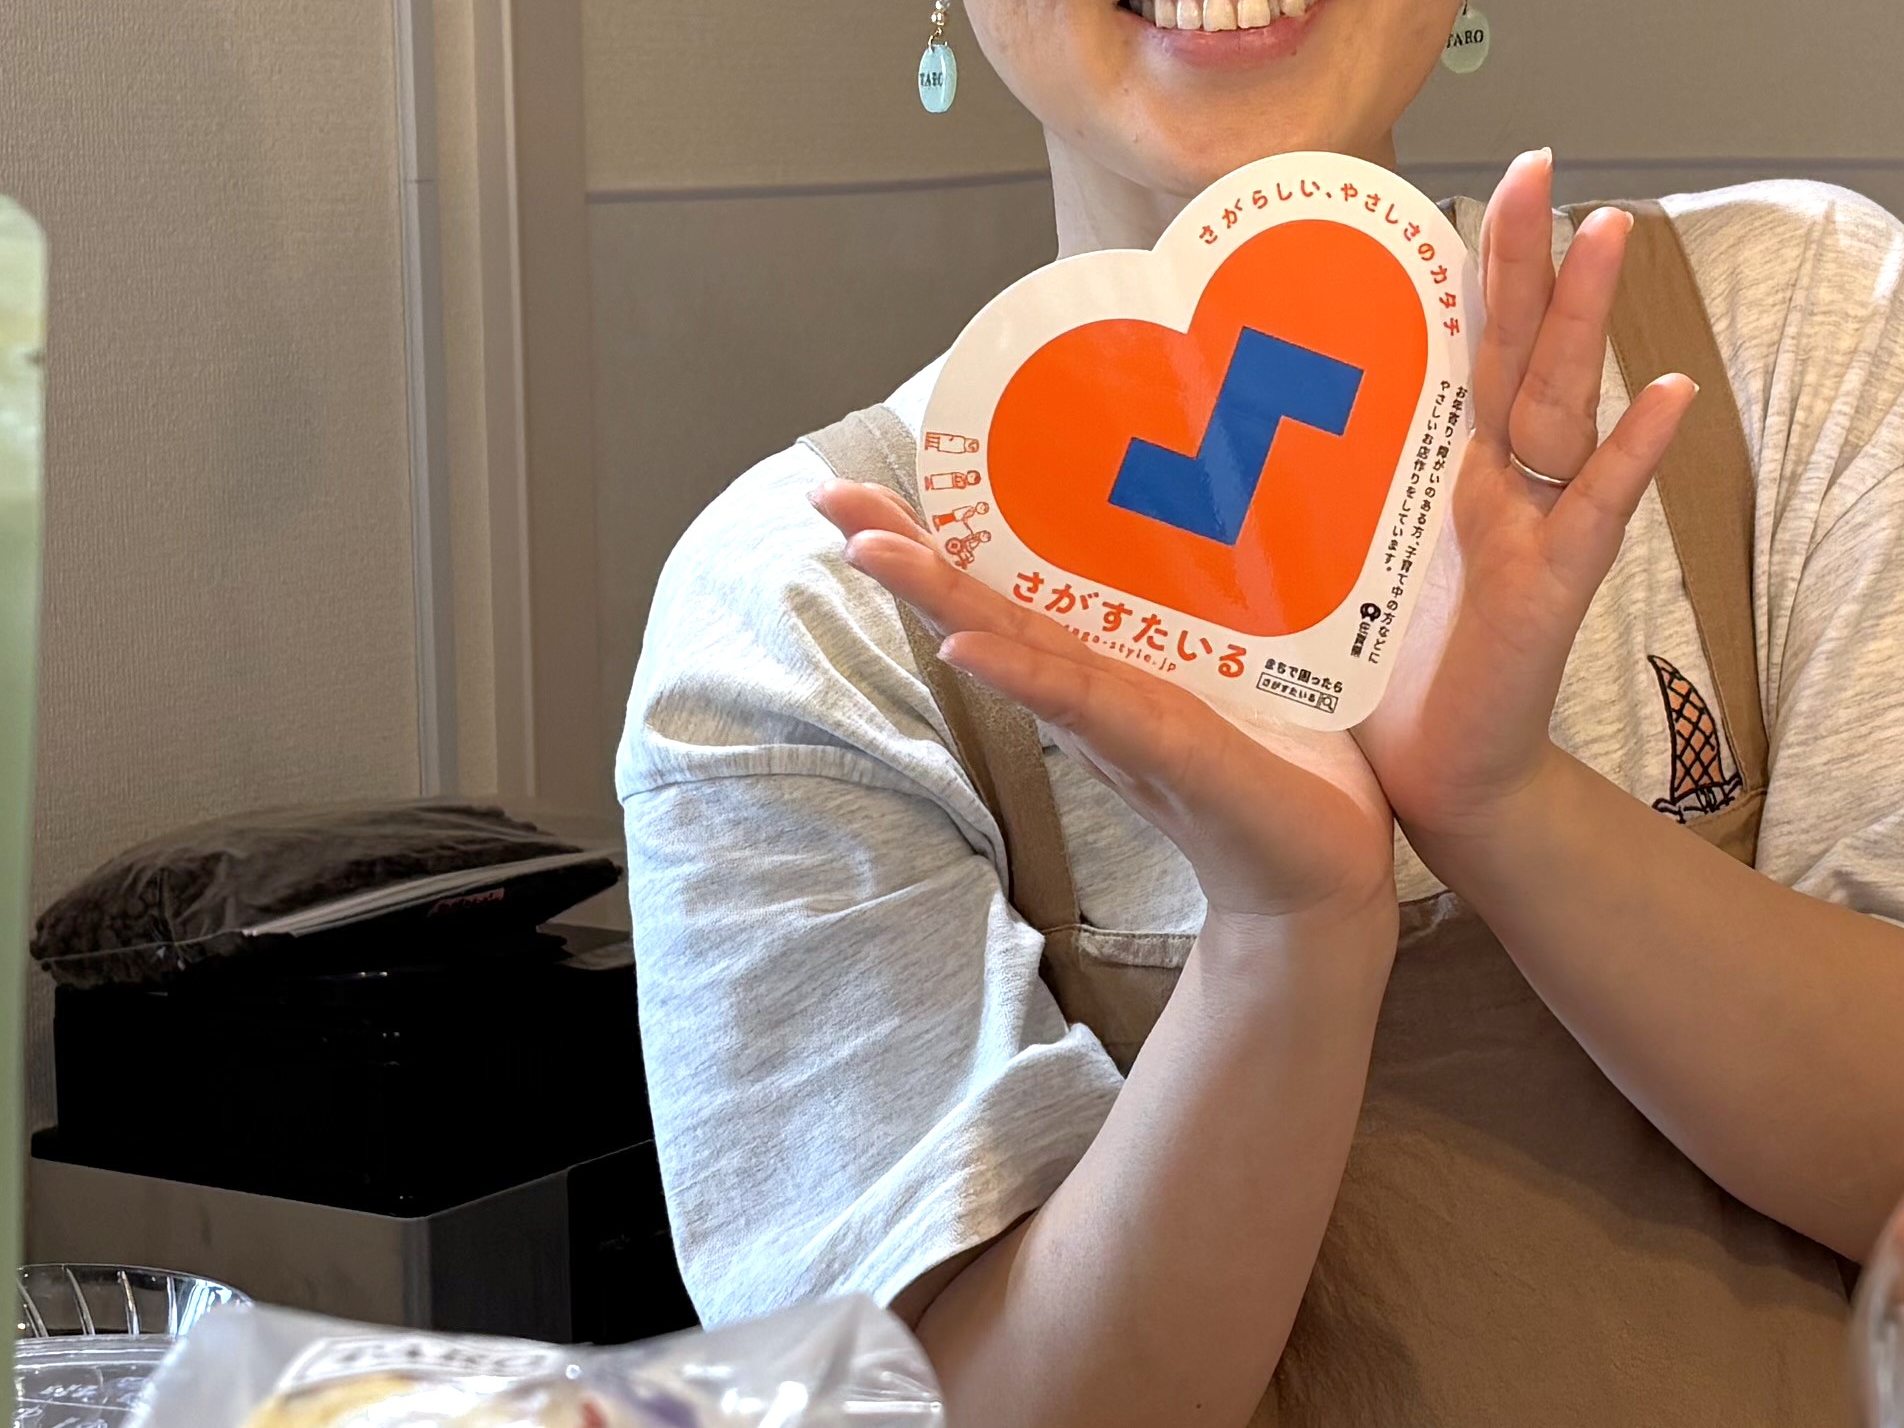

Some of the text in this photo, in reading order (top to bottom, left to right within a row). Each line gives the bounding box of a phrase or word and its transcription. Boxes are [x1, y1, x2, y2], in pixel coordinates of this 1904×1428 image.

[1199, 178, 1461, 336] さがらしい、やさしさのカタチ
[1013, 571, 1247, 678] さがすたいる
[1264, 658, 1343, 693] まちで困ったら
